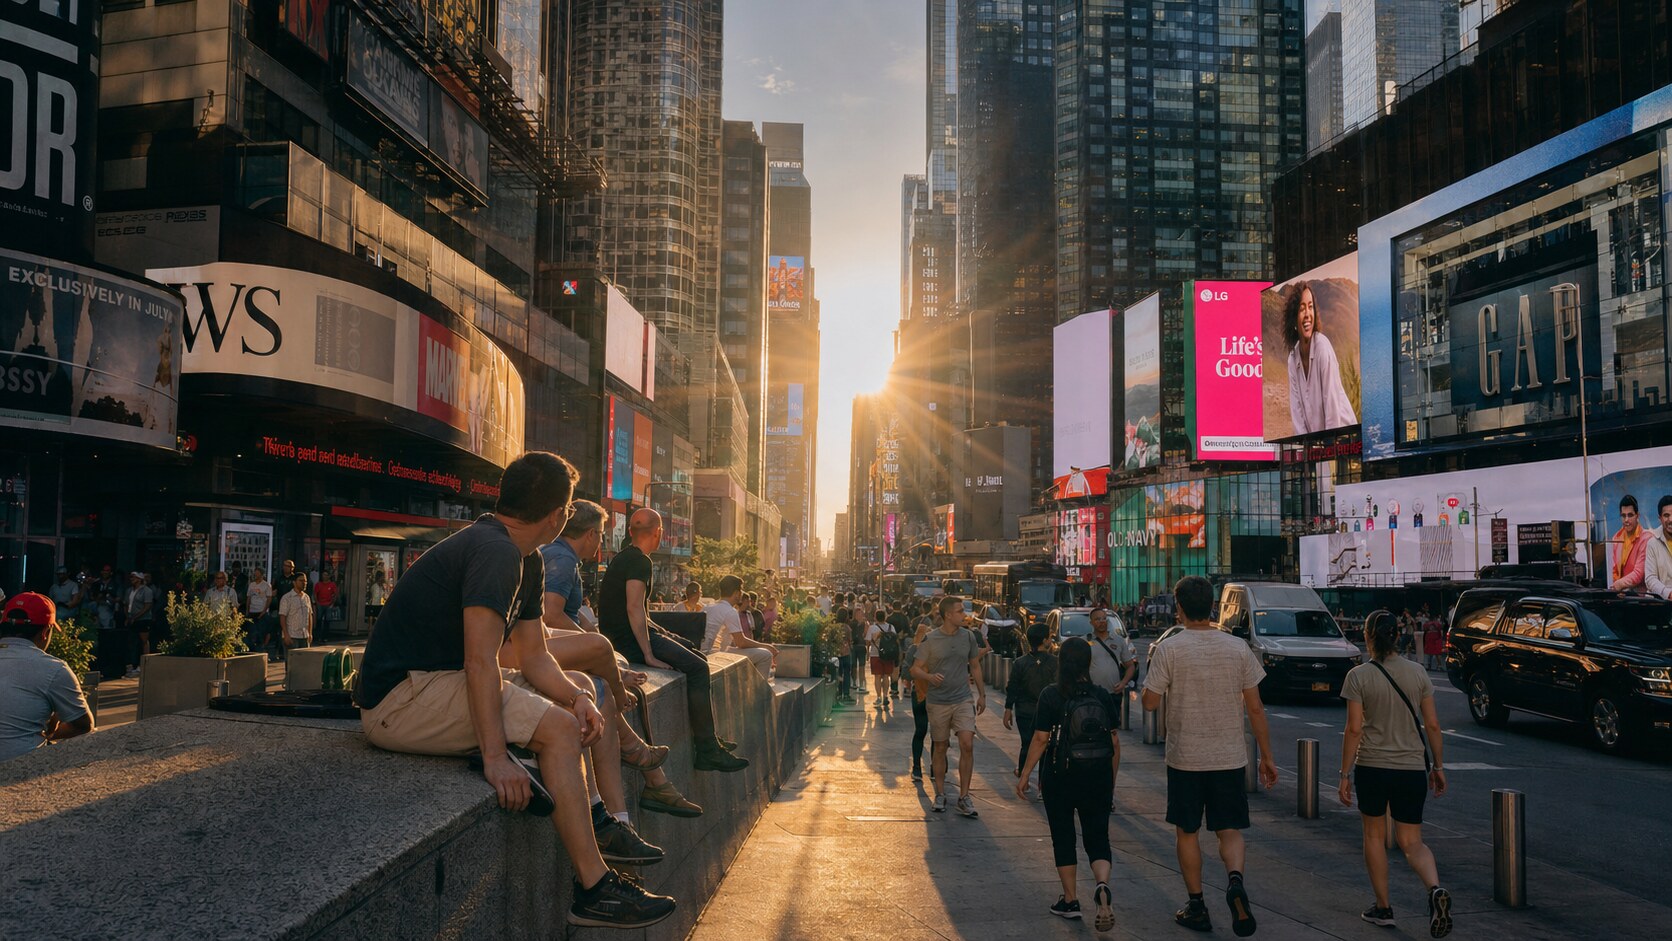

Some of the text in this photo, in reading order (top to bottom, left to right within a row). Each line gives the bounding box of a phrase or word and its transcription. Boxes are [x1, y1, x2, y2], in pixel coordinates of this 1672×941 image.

[8, 265, 169, 321] EXCLUSIVELY IN JULY
[1214, 291, 1228, 301] LG
[1478, 282, 1579, 397] GAP
[1107, 529, 1157, 548] OLD NAVY
